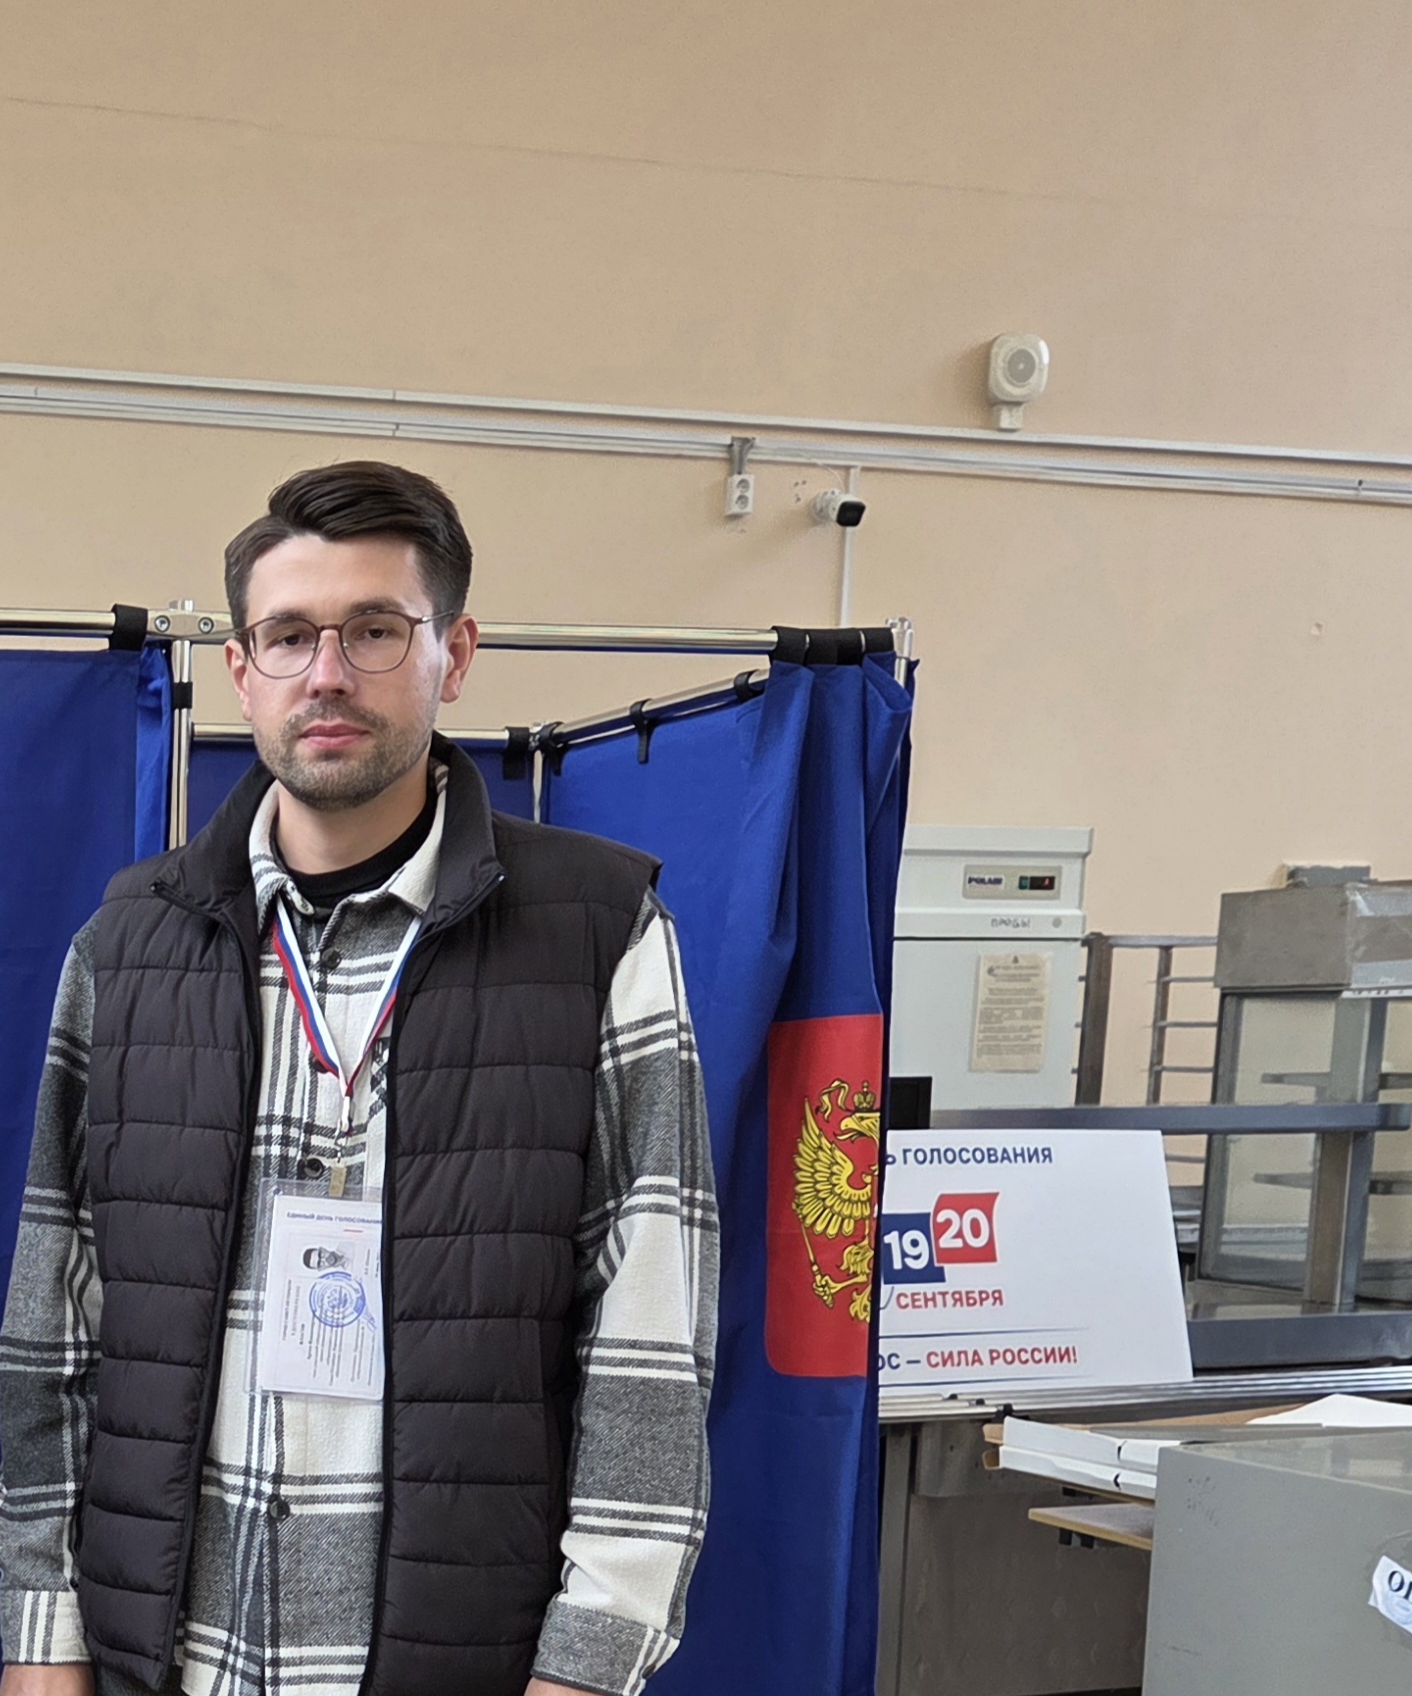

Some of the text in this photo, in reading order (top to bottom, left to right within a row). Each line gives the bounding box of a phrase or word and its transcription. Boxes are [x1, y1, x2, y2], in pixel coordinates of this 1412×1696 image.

[902, 1147, 1053, 1164] ГОЛОСОВАНИЯ
[937, 1208, 989, 1248] 20
[884, 1230, 930, 1270] 19
[896, 1289, 1003, 1310] СЕНТЯБРЯ
[926, 1350, 984, 1368] СИЛА
[990, 1346, 1078, 1365] РОССИИ!
